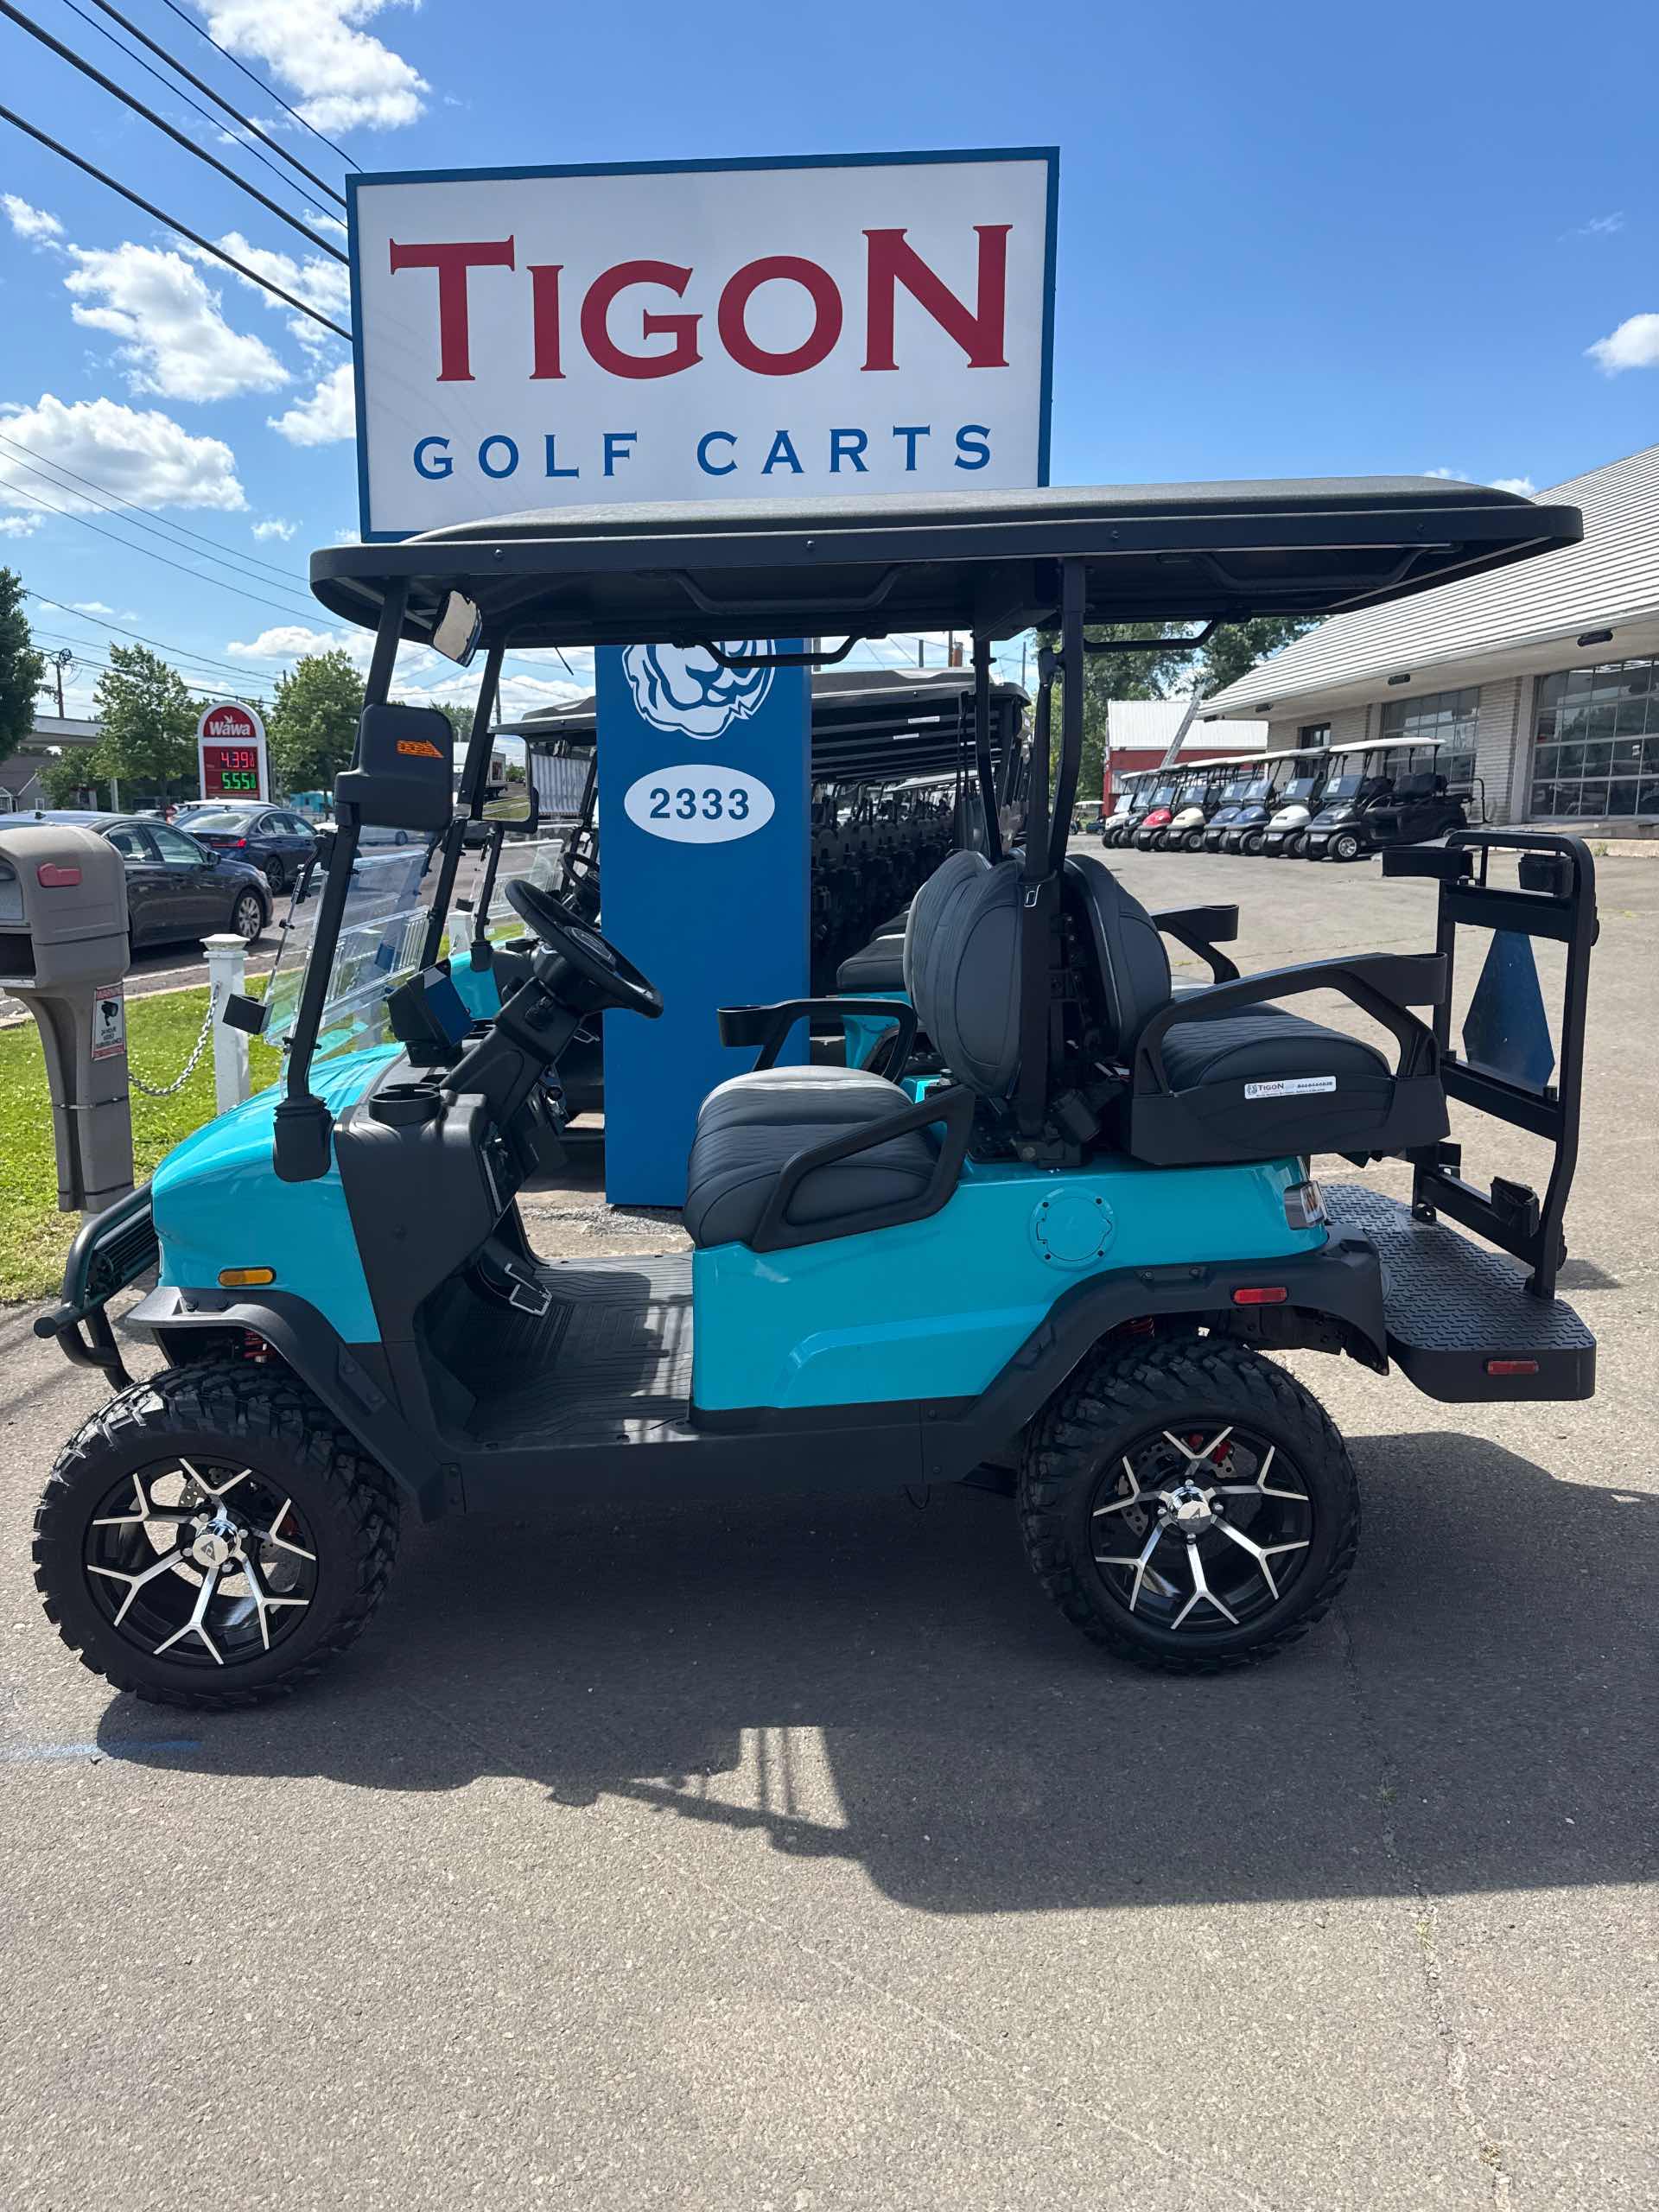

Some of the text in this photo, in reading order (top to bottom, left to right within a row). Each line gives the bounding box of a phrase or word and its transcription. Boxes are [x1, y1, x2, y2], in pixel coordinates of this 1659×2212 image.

[390, 225, 1013, 381] TIGON
[413, 424, 992, 480] GOLF CARTS
[209, 721, 251, 735] Wawa
[649, 787, 749, 820] 2333
[1257, 1083, 1285, 1091] TIGON
